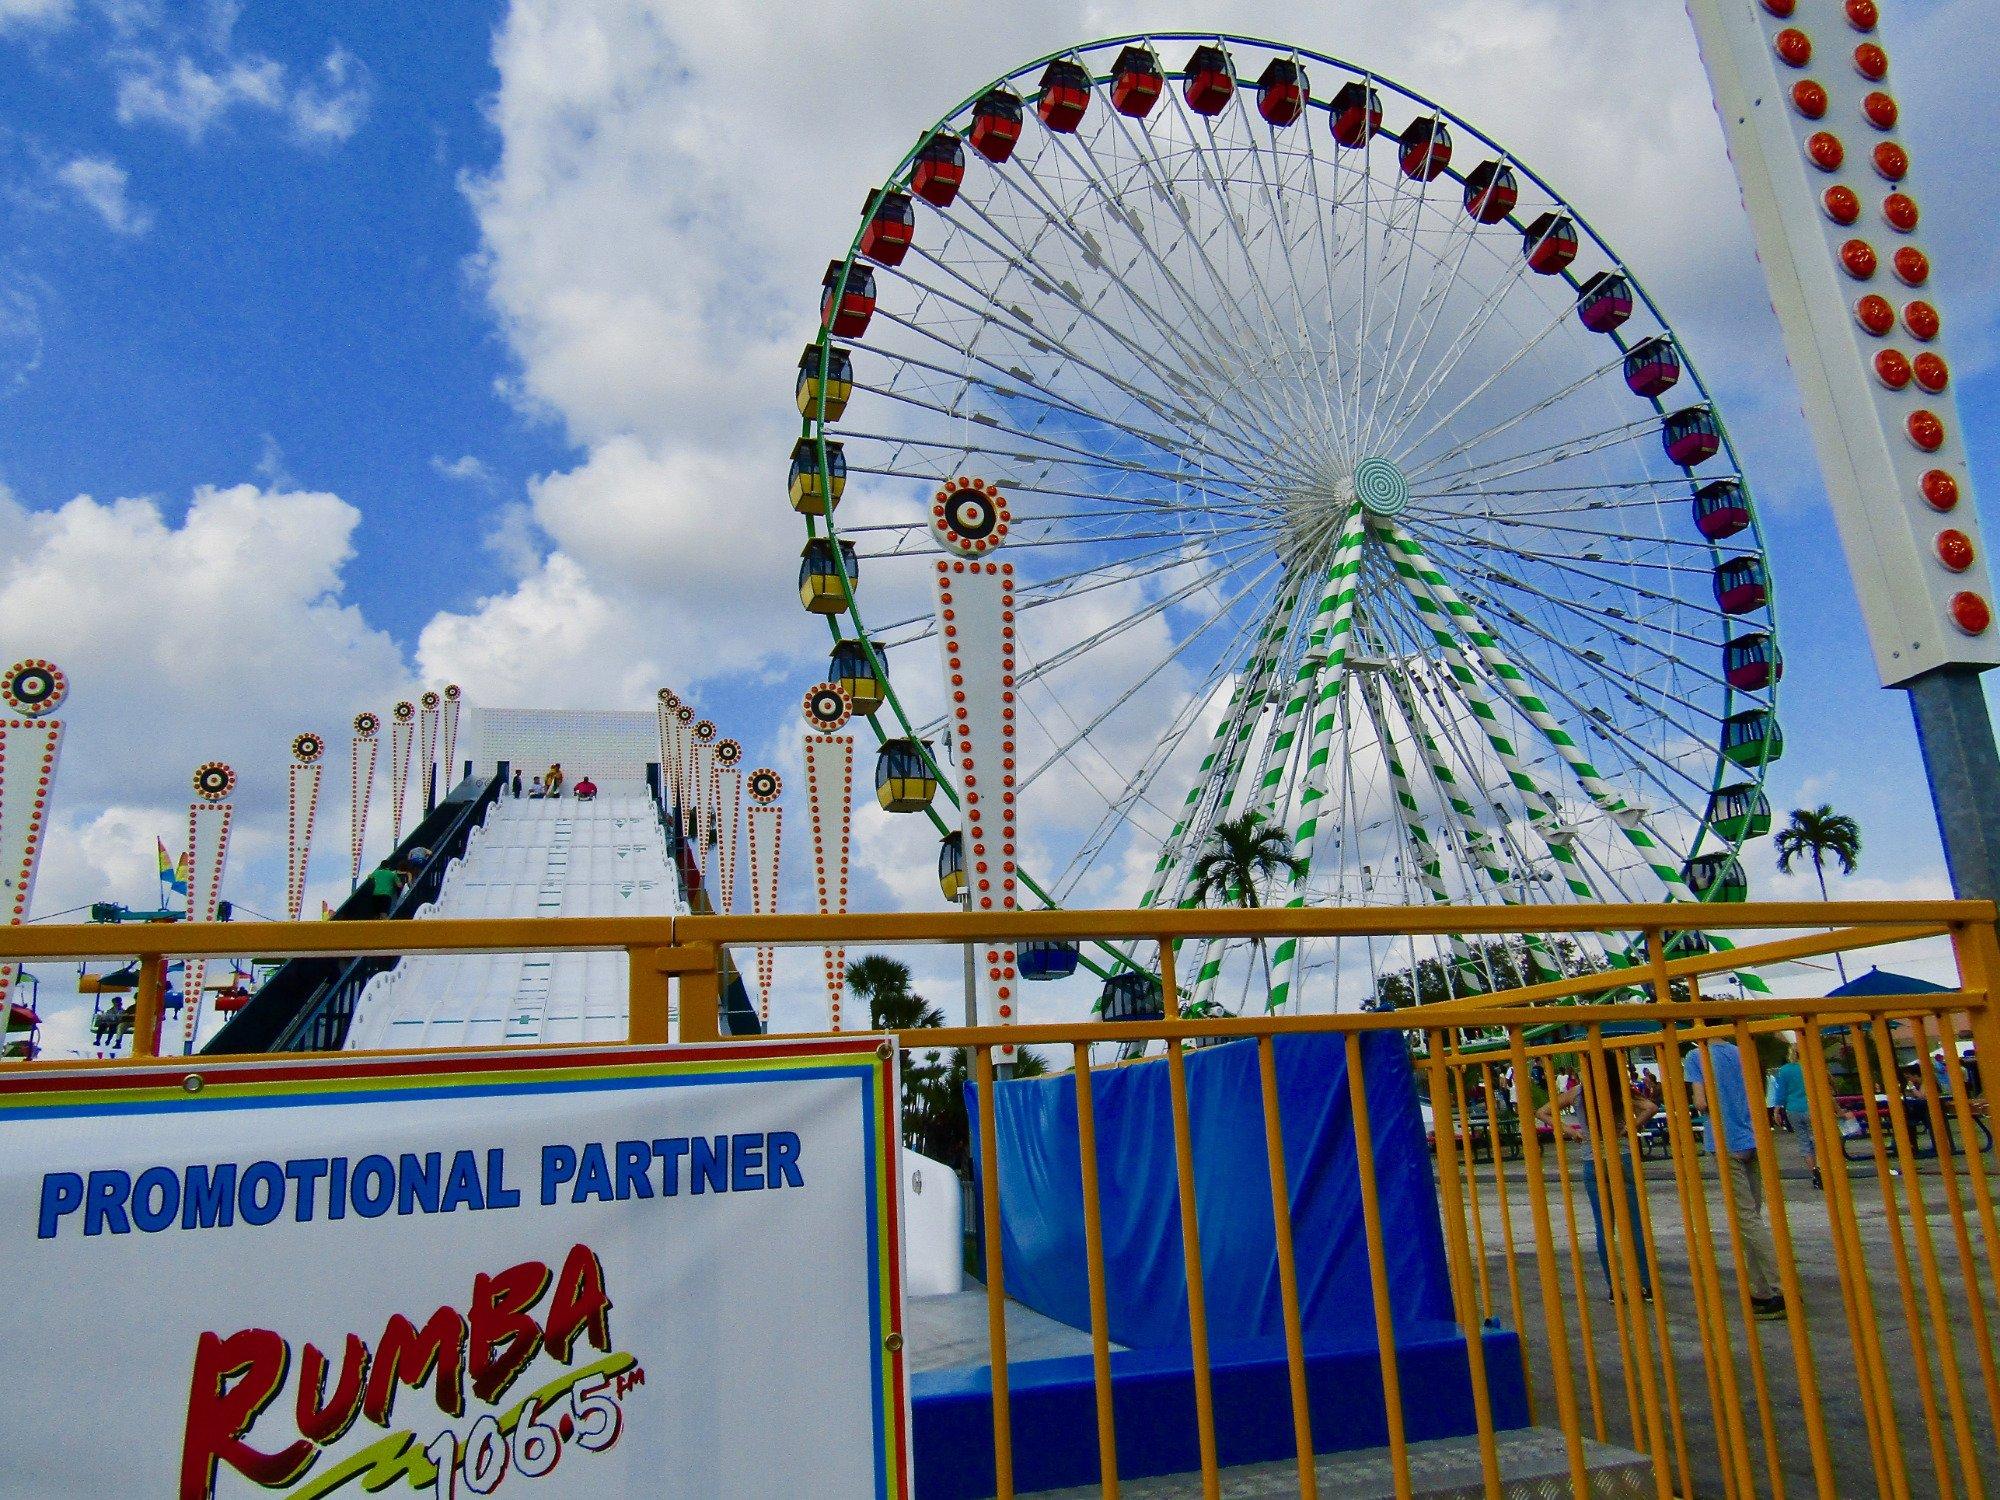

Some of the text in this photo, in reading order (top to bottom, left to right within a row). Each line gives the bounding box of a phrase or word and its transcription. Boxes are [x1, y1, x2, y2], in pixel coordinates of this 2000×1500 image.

[38, 1131, 804, 1240] PROMOTIONAL PARTNER
[180, 1243, 613, 1500] RUMBA
[425, 1367, 646, 1500] 106.5 FM
